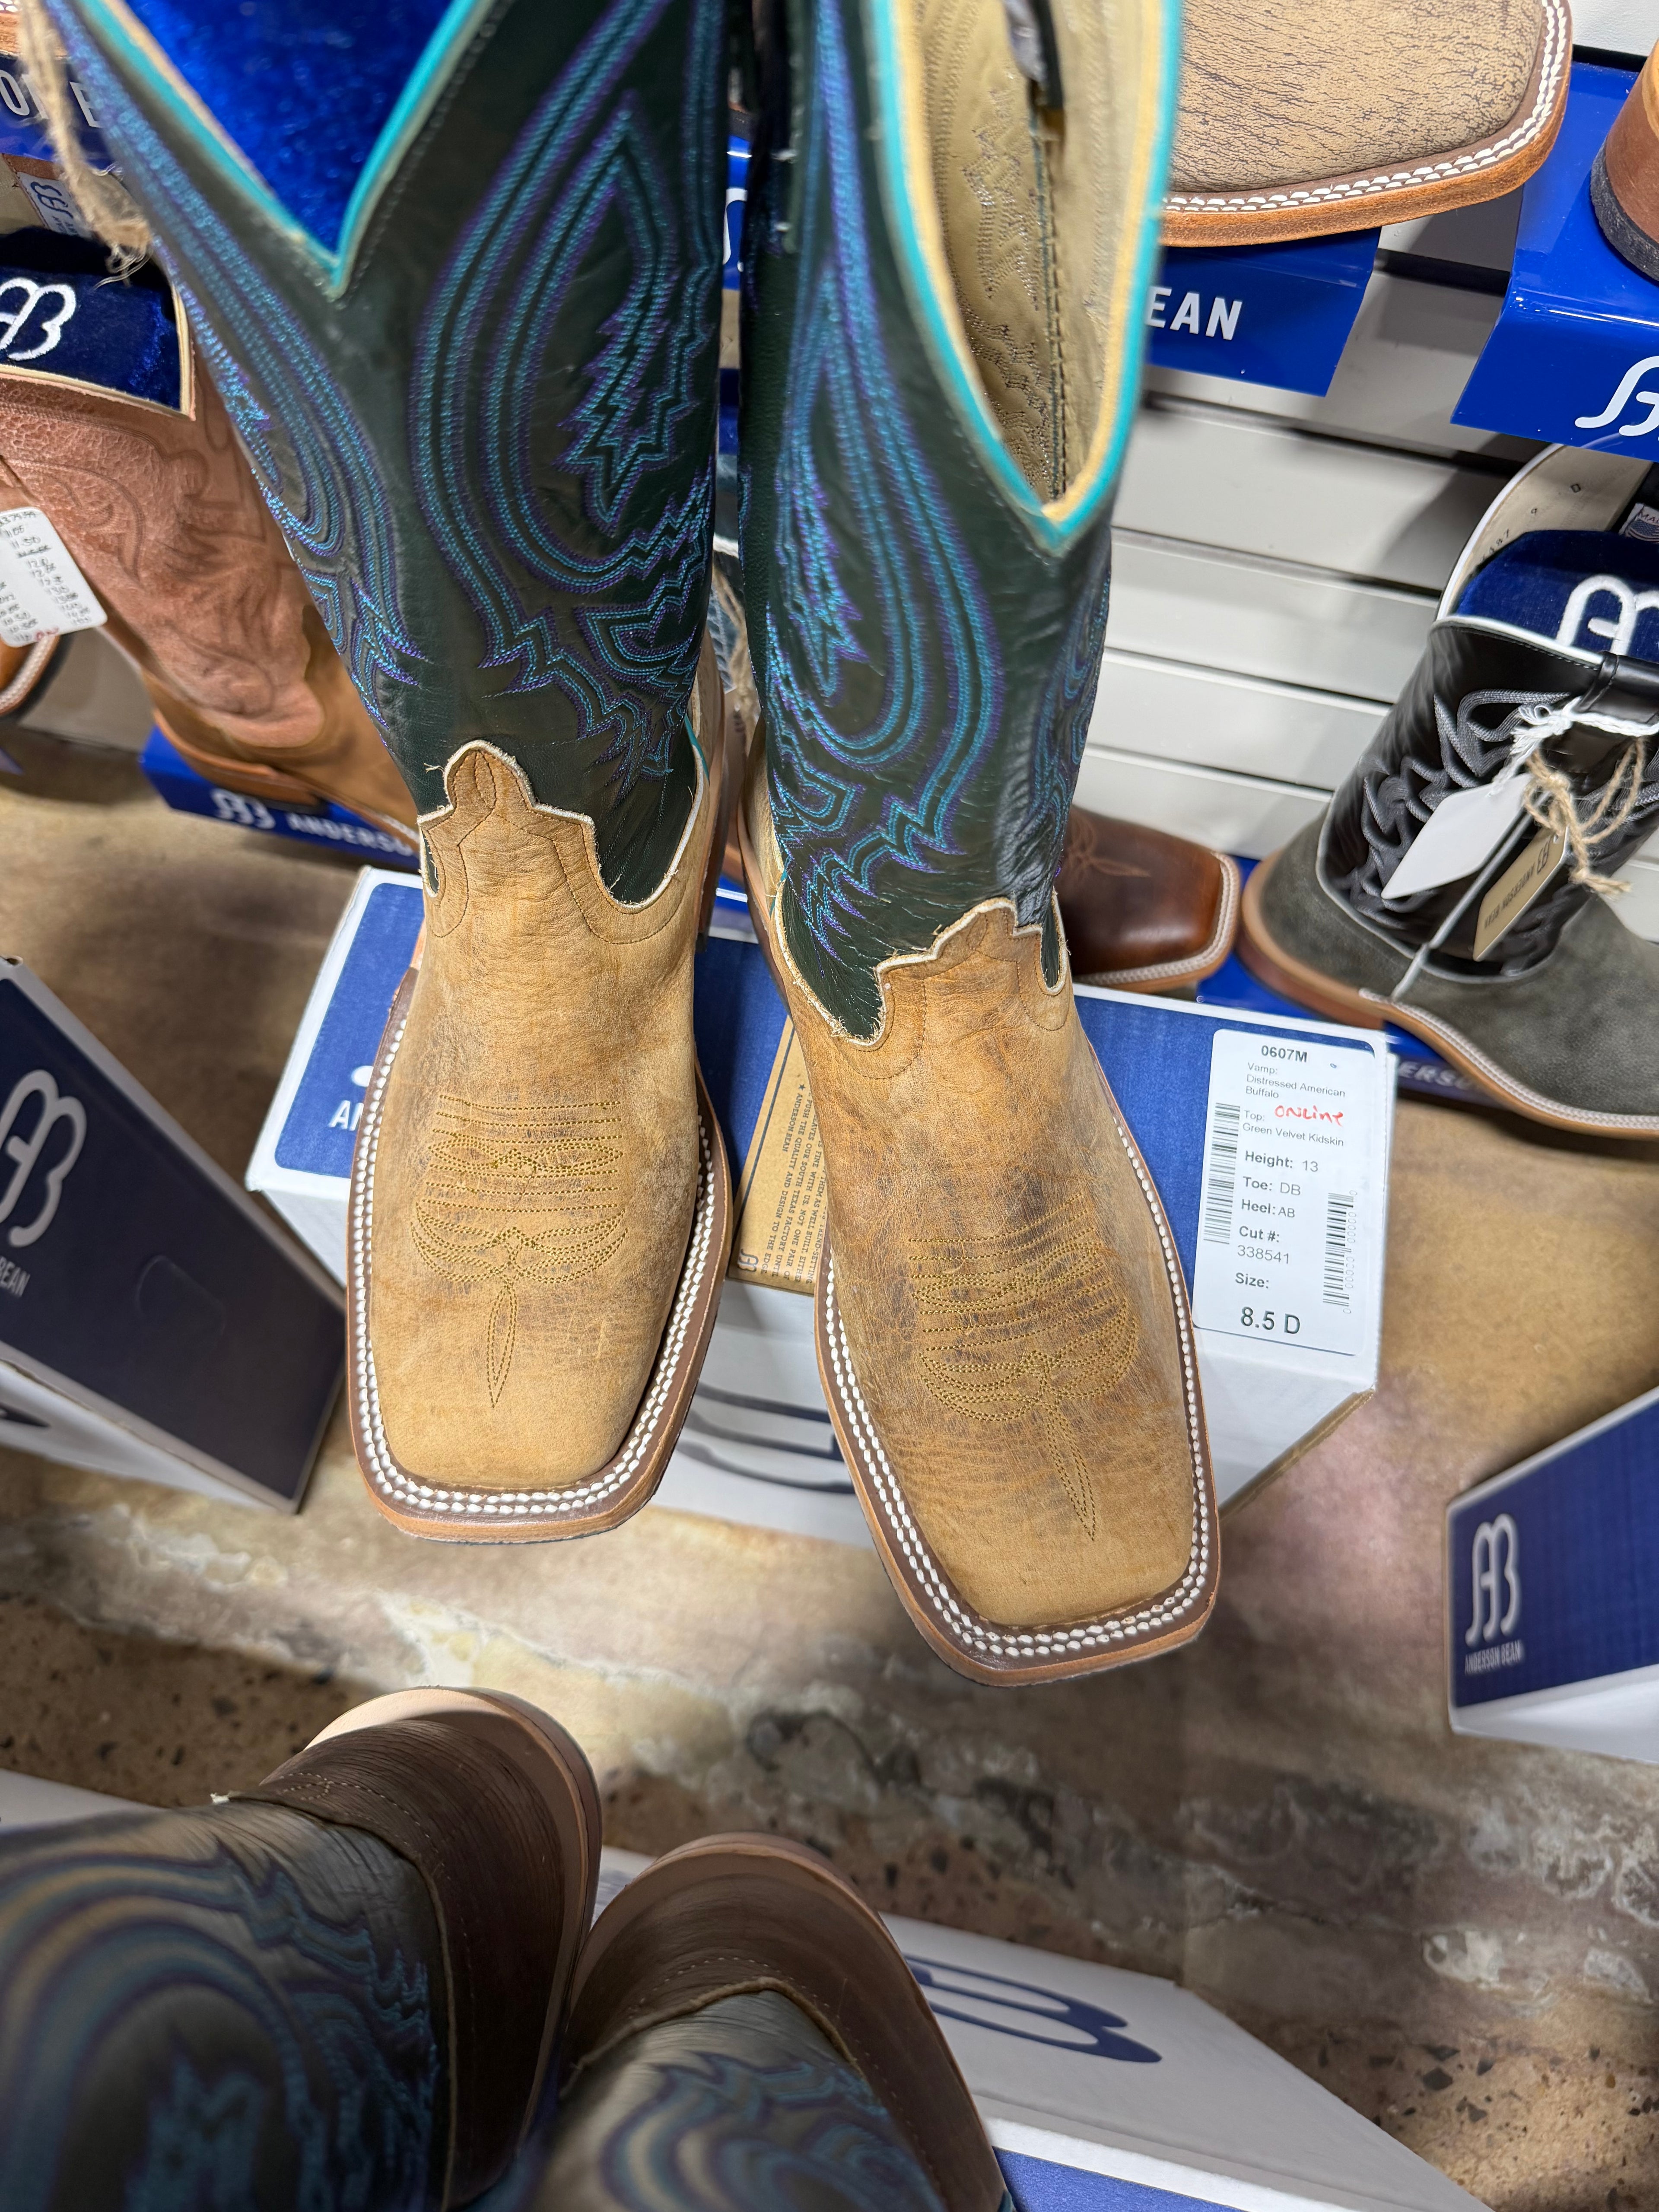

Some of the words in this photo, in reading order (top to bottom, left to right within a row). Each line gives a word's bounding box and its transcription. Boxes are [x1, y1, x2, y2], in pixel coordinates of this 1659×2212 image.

[1261, 1045, 1307, 1062] 0607M
[1248, 1062, 1278, 1075] Vamp:
[1246, 1086, 1279, 1098] Buffalo
[1247, 1074, 1296, 1089] Distressed
[1300, 1083, 1345, 1097] American
[787, 1093, 803, 1131] ANDERSON
[802, 1099, 812, 1118] PUSH
[1244, 1110, 1265, 1121] Top:
[798, 1120, 807, 1135] THE
[1243, 1123, 1271, 1135] Green
[1276, 1128, 1305, 1140] Velvet
[1309, 1133, 1344, 1146] Kidskin
[782, 1132, 792, 1152] BEAN
[803, 1143, 812, 1159] OUR
[788, 1137, 802, 1169] QUALITY
[812, 1150, 821, 1168] FINE
[1245, 1150, 1293, 1168] Height:
[1303, 1160, 1318, 1172] 13
[783, 1171, 793, 1188] AND
[795, 1161, 807, 1186] SOUTH
[806, 1170, 816, 1192] WITH
[1243, 1176, 1272, 1191] Toe:
[1280, 1182, 1300, 1195] DB
[775, 1190, 788, 1218] DESIGN
[788, 1189, 800, 1214] TEXAS
[802, 1194, 810, 1206] US.
[813, 1198, 820, 1208] AS
[1241, 1199, 1275, 1214] Heel:
[1278, 1207, 1295, 1217] AB
[772, 1220, 779, 1232] TO
[797, 1209, 806, 1226] NOT
[807, 1209, 818, 1230] WELL
[766, 1233, 776, 1250] THE
[778, 1216, 793, 1251] FACTORY
[791, 1229, 801, 1245] ONE
[801, 1231, 812, 1254] BUILT.
[1239, 1226, 1263, 1239] Cut
[1268, 1231, 1279, 1243] #:
[786, 1249, 796, 1267] PAIR
[1237, 1245, 1289, 1264] 338541
[771, 1254, 783, 1278] UNTIL
[783, 1270, 790, 1280] OF
[794, 1255, 806, 1282] EITHER
[1235, 1272, 1269, 1289] Size:
[1241, 1306, 1274, 1330] 8.5
[1284, 1313, 1300, 1334] D
[1464, 1646, 1500, 1676] ANDERSON
[1501, 1640, 1524, 1666] BEAN
